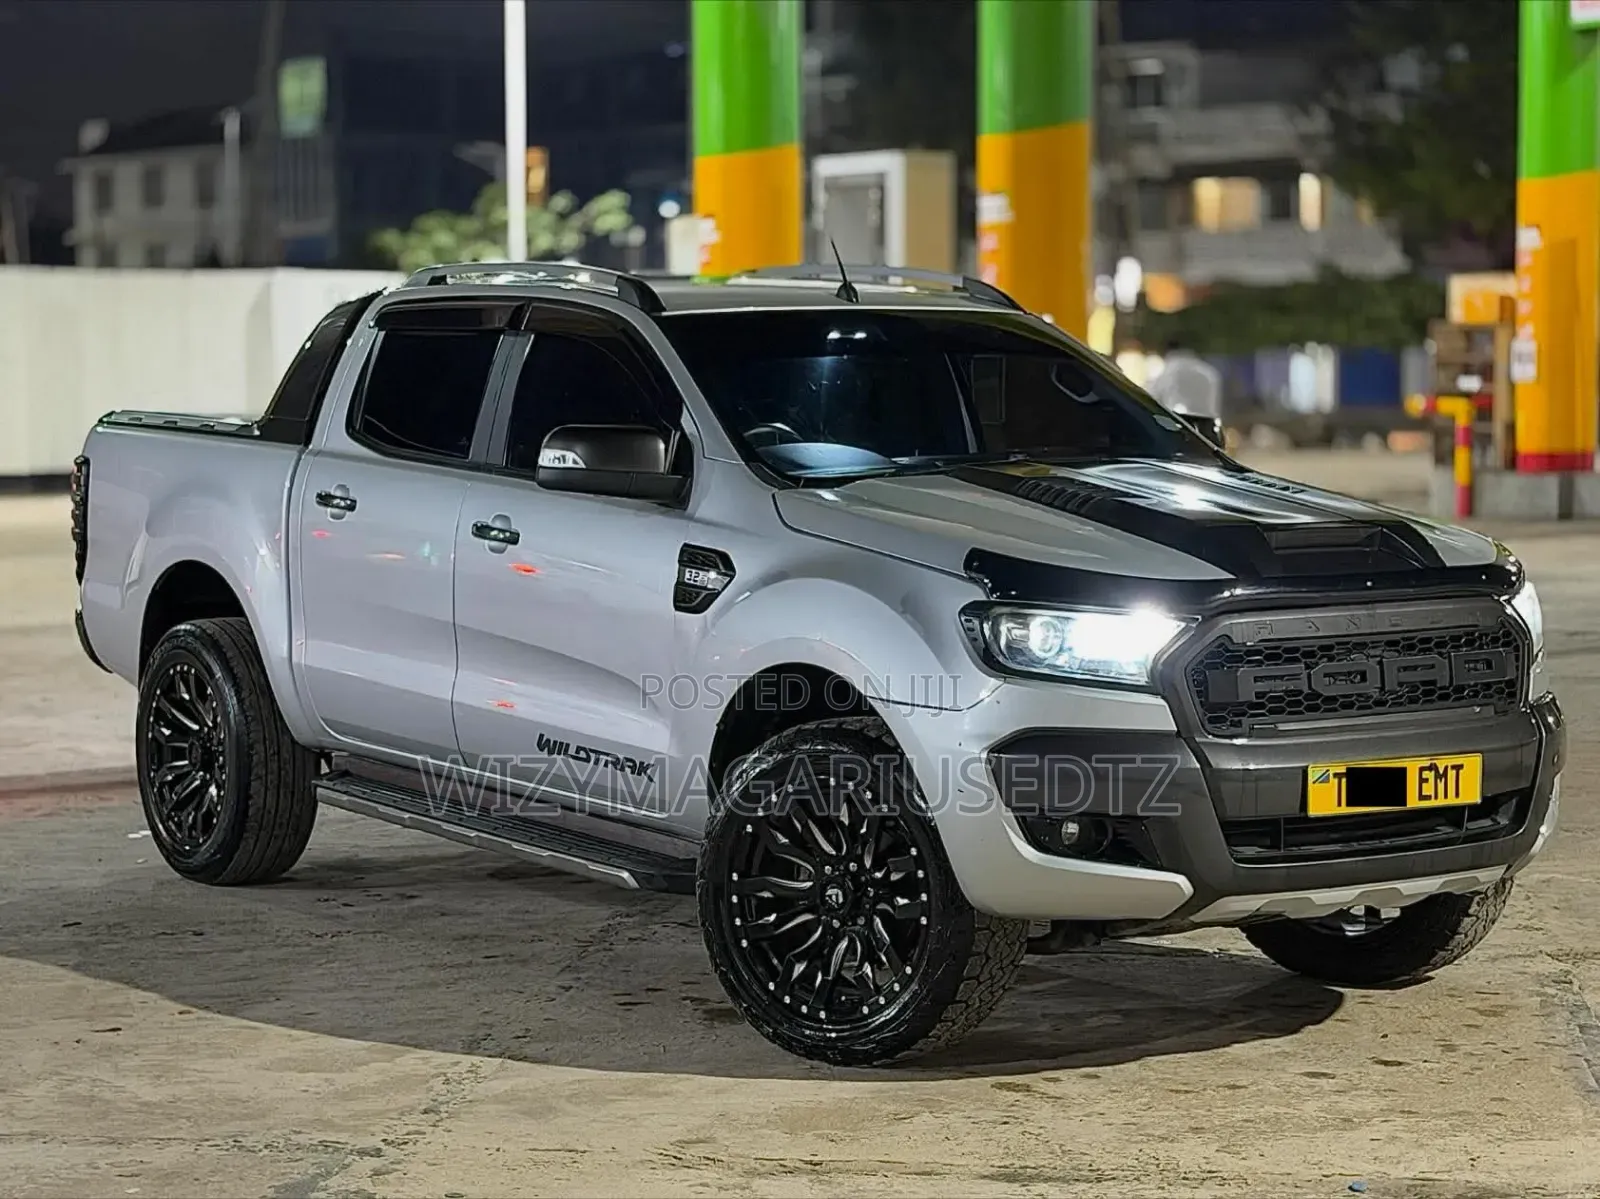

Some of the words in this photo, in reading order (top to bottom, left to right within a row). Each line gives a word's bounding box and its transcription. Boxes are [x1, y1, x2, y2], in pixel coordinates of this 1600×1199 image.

[1253, 609, 1482, 637] RAN
[1236, 649, 1508, 701] FORD
[536, 732, 656, 784] WILDTRAK
[1332, 771, 1347, 808] T
[1417, 762, 1465, 802] EMT
